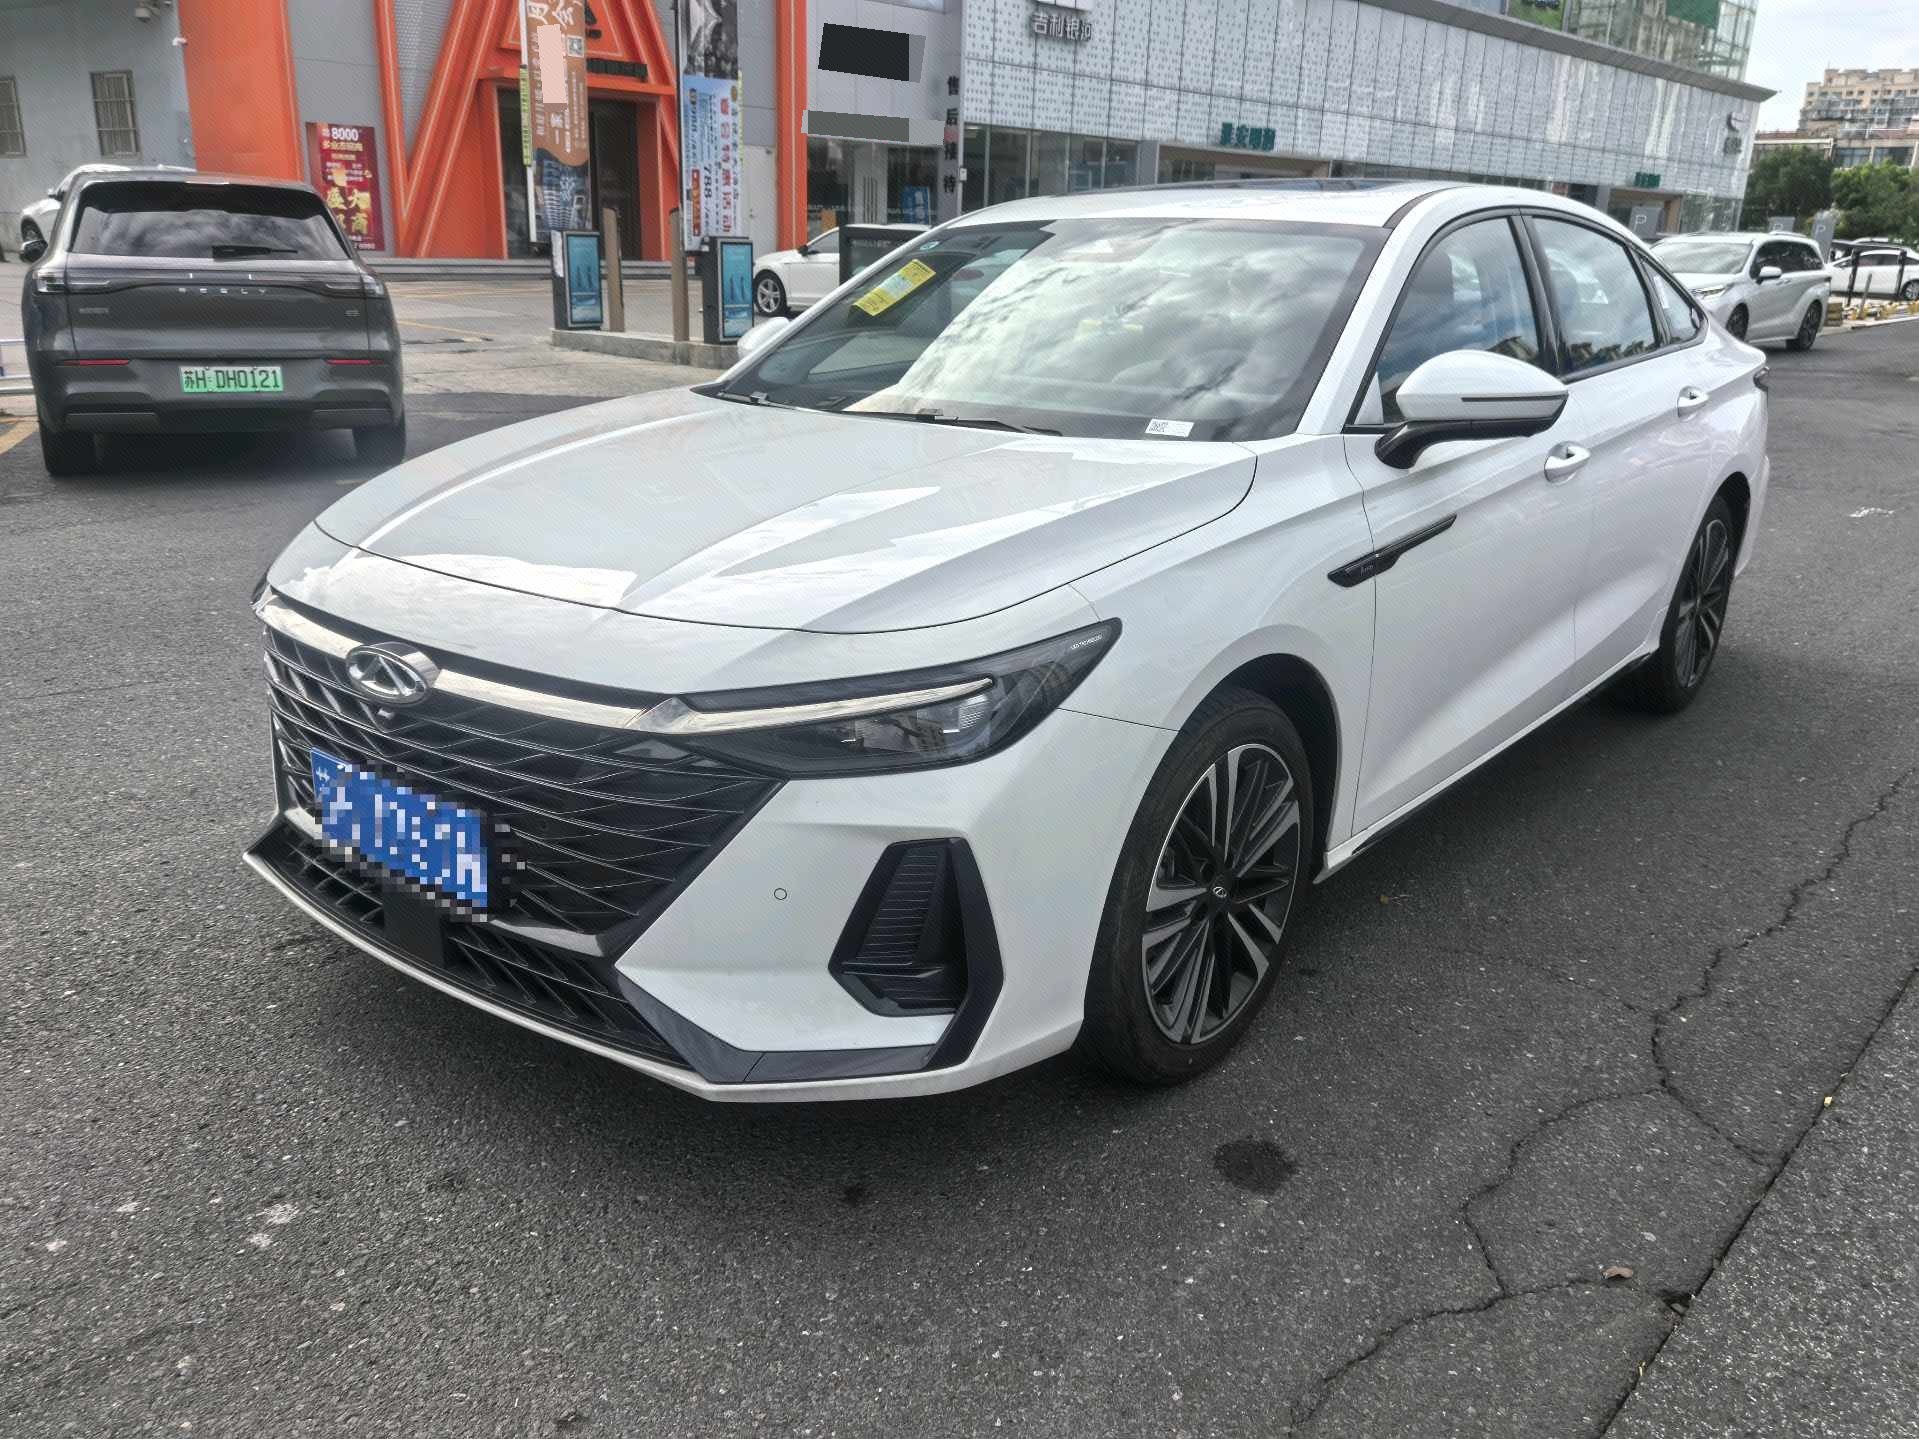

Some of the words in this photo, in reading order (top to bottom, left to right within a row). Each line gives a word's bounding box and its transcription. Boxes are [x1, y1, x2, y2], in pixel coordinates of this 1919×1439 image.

[1032, 12, 1092, 41] 吉利银河
[331, 127, 359, 141] 8000
[1634, 214, 1647, 234] P
